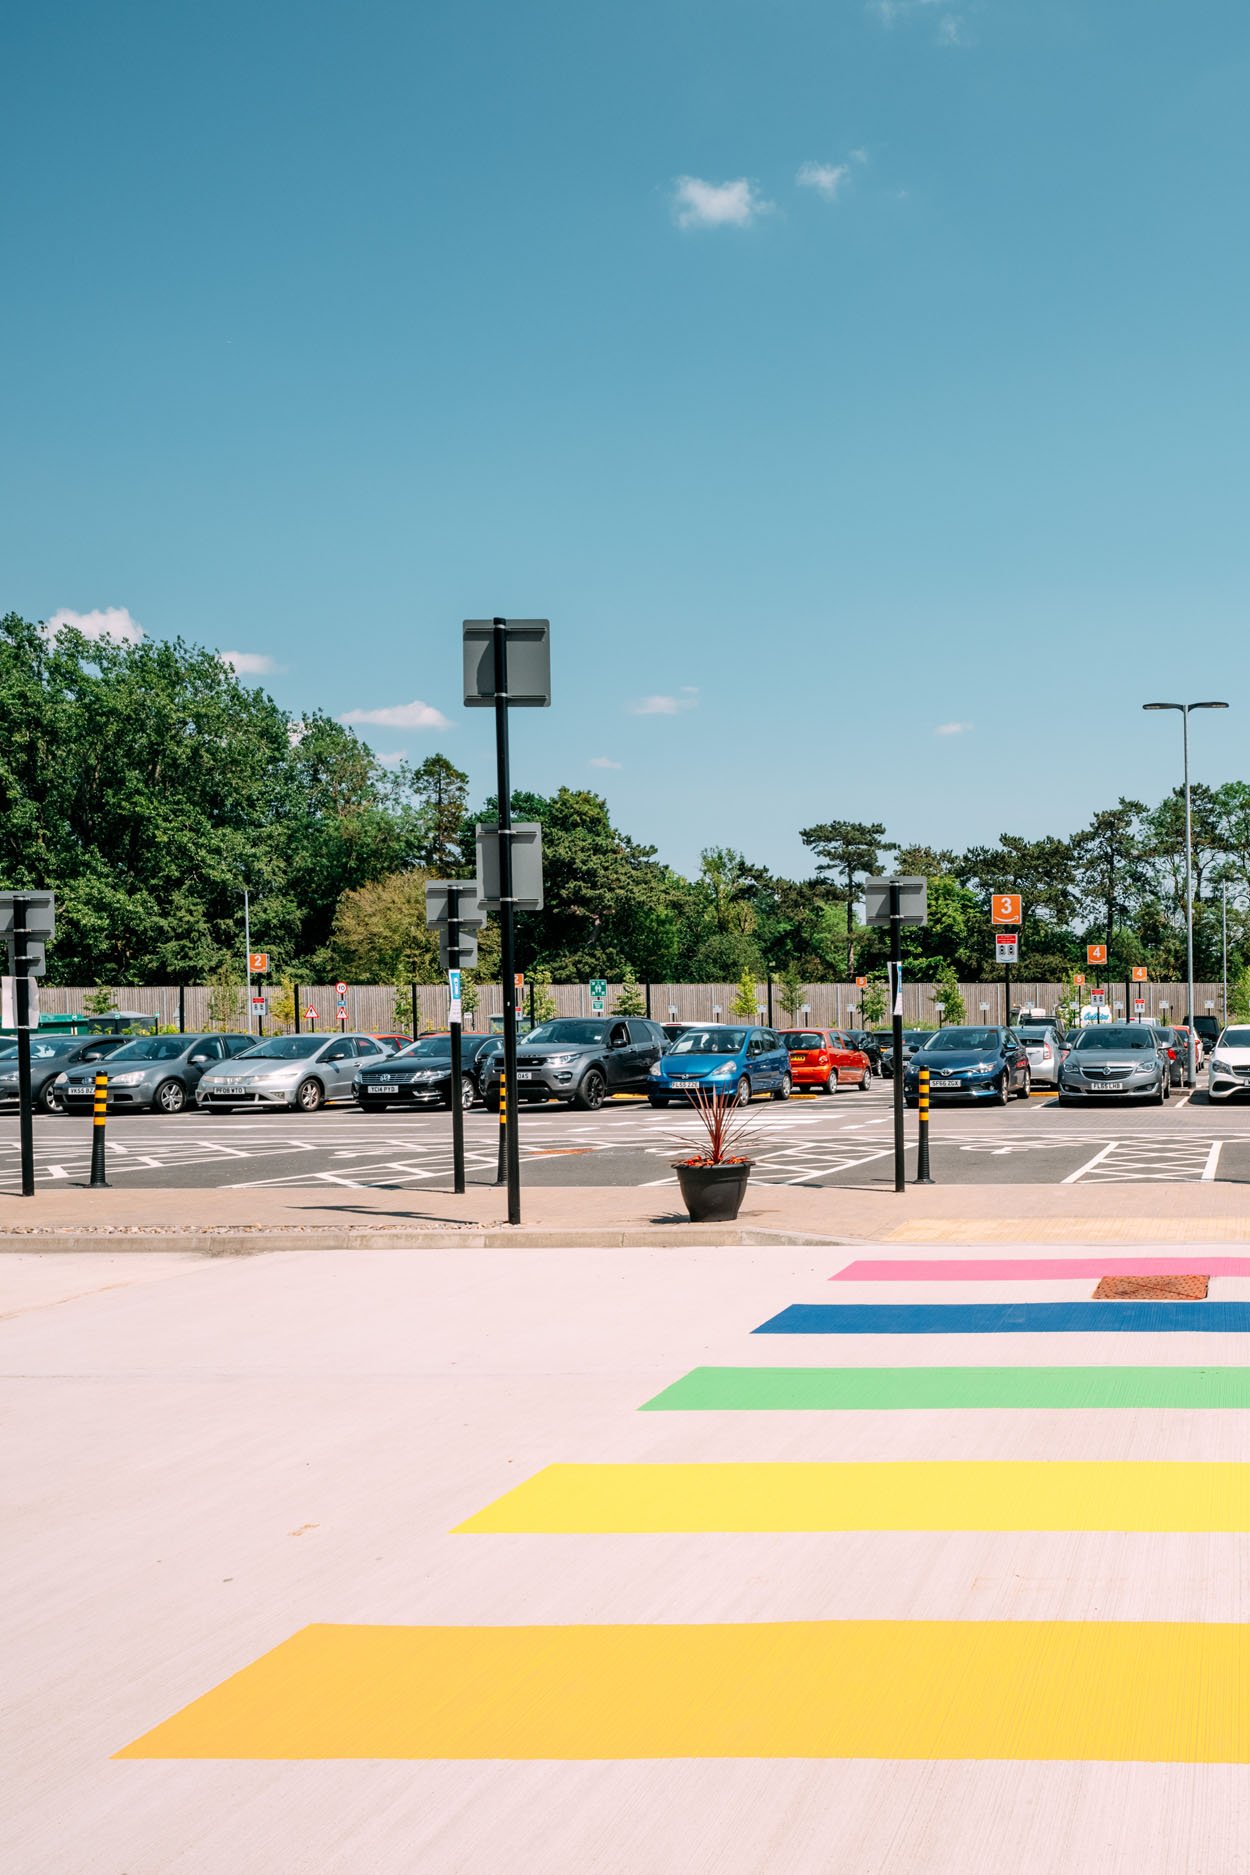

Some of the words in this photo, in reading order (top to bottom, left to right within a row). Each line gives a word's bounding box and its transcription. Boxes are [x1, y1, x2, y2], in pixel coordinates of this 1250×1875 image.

[1001, 897, 1012, 914] 3
[1092, 946, 1100, 958] 4
[254, 955, 262, 967] 2
[1136, 968, 1142, 977] 4
[1076, 975, 1082, 983] 5
